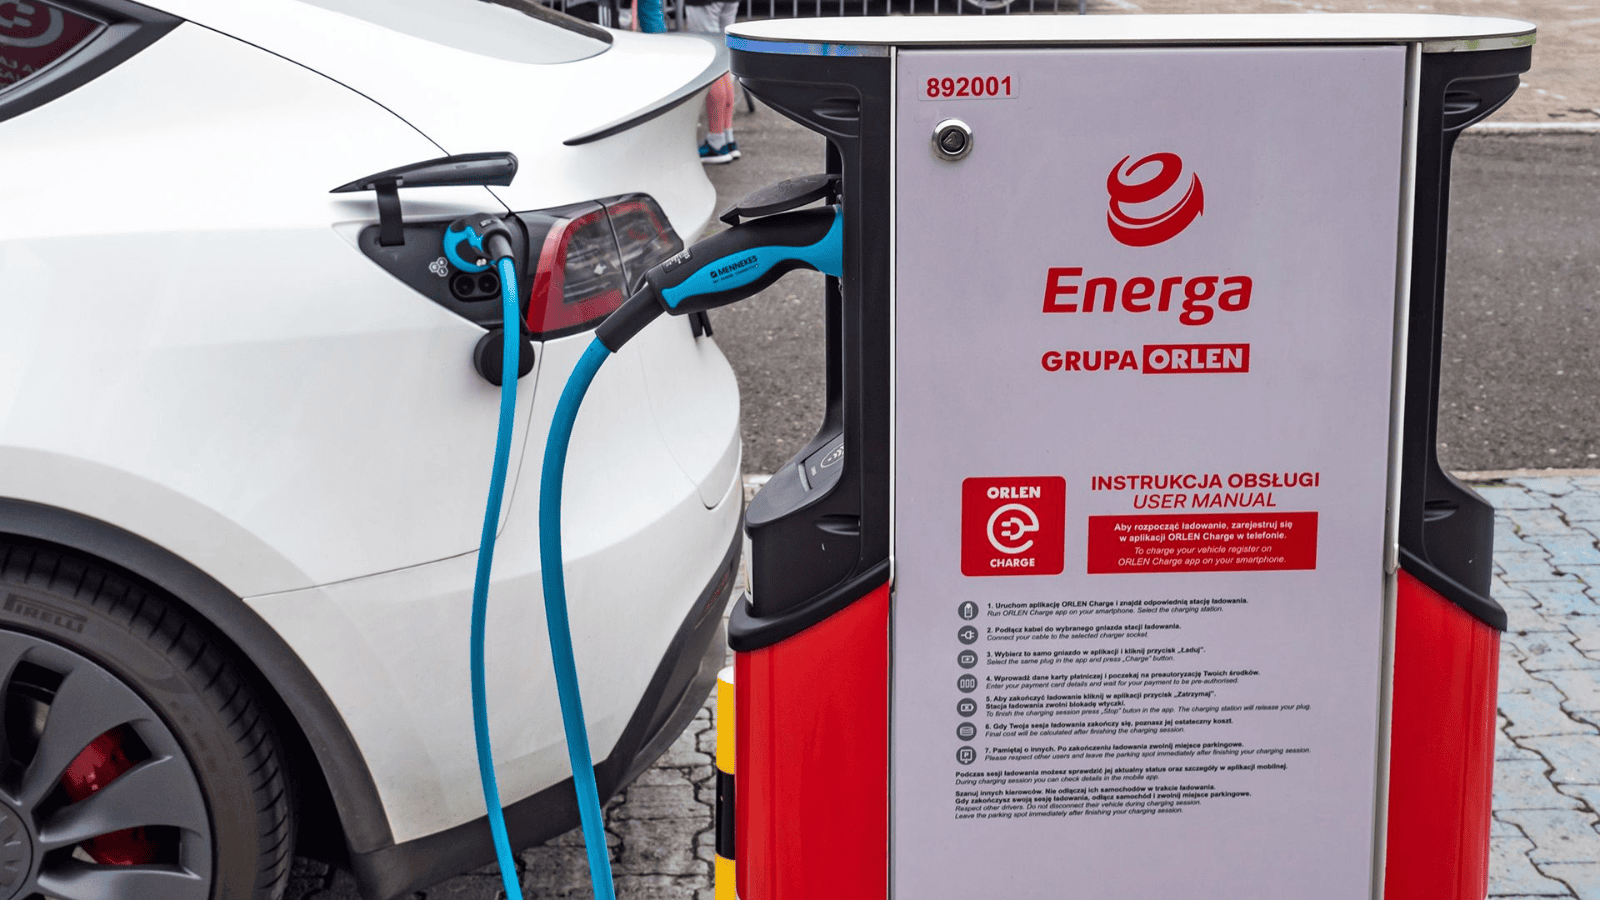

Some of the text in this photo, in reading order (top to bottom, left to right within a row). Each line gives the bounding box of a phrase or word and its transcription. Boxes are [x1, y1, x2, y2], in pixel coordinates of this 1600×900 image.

[926, 76, 1012, 98] 892001
[717, 255, 758, 276] MENNEKES
[1042, 267, 1253, 326] Energa
[1041, 348, 1243, 372] GRUPA ORLEN
[1091, 472, 1320, 491] INSTRUKCJA OBSŁUGI
[987, 486, 1041, 499] ORLEN
[1133, 492, 1277, 509] USER MANUAL
[1114, 520, 1292, 532] Aby rozpocząć ładowanie, zarejestruj się
[1129, 533, 1165, 543] aplikacji
[1168, 532, 1200, 540] ORLEN
[1202, 532, 1234, 541] Charge
[1246, 531, 1285, 539] telefonie.
[1135, 546, 1143, 554] To
[1146, 546, 1174, 555] charge
[1176, 547, 1194, 555] your
[1197, 545, 1225, 553] vehicle
[1228, 545, 1258, 554] register
[990, 558, 1035, 568] CHARGE
[1118, 557, 1150, 566] ORLEN
[1152, 557, 1182, 566] Charge
[1214, 557, 1233, 565] your
[1235, 555, 1285, 564] smartphone.
[1028, 601, 1059, 609] aplikację
[1088, 600, 1114, 608] Charge
[1119, 599, 1142, 607] znajdź
[1143, 598, 1188, 606] odpowiednią
[4, 594, 88, 633] PIRELLI
[994, 626, 1022, 634] Podłącz
[1095, 624, 1122, 632] gniazda
[994, 650, 1022, 658] Wybierz
[1053, 649, 1080, 657] gniazdo
[1090, 648, 1118, 656] aplikacji
[993, 674, 1030, 682] Wprowadź
[1069, 672, 1103, 680] płatniczej
[1108, 672, 1139, 680] poczekaj
[993, 695, 1007, 703] Aby
[1008, 694, 1045, 702] zakończyć
[1113, 692, 1142, 700] aplikacji
[1143, 691, 1172, 699] przycisk
[985, 701, 1007, 710] Stacja
[1008, 700, 1043, 708] ładowania
[1068, 700, 1096, 708] blokadę
[1098, 699, 1124, 707] wtyczki.
[992, 722, 1007, 730] Gdy
[1009, 722, 1029, 730] Twoja
[1087, 720, 1119, 728] zakończy
[1174, 718, 1211, 726] ostateczny
[992, 746, 1022, 754] Pamiętaj
[1148, 742, 1173, 750] zwolnij
[1202, 741, 1244, 749] parkingowe.
[1068, 767, 1102, 775] sprawdzić
[1114, 766, 1143, 774] aktualny
[954, 797, 969, 805] Gdy
[970, 795, 1010, 804] zakończysz
[1012, 796, 1032, 804] swoją
[1053, 793, 1089, 801] ładowania,
[1115, 792, 1151, 800] samochód
[1182, 791, 1208, 799] miejsce
[1210, 790, 1251, 798] parkingowe.
[980, 789, 1003, 797] innych
[1058, 787, 1086, 795] odłączaj
